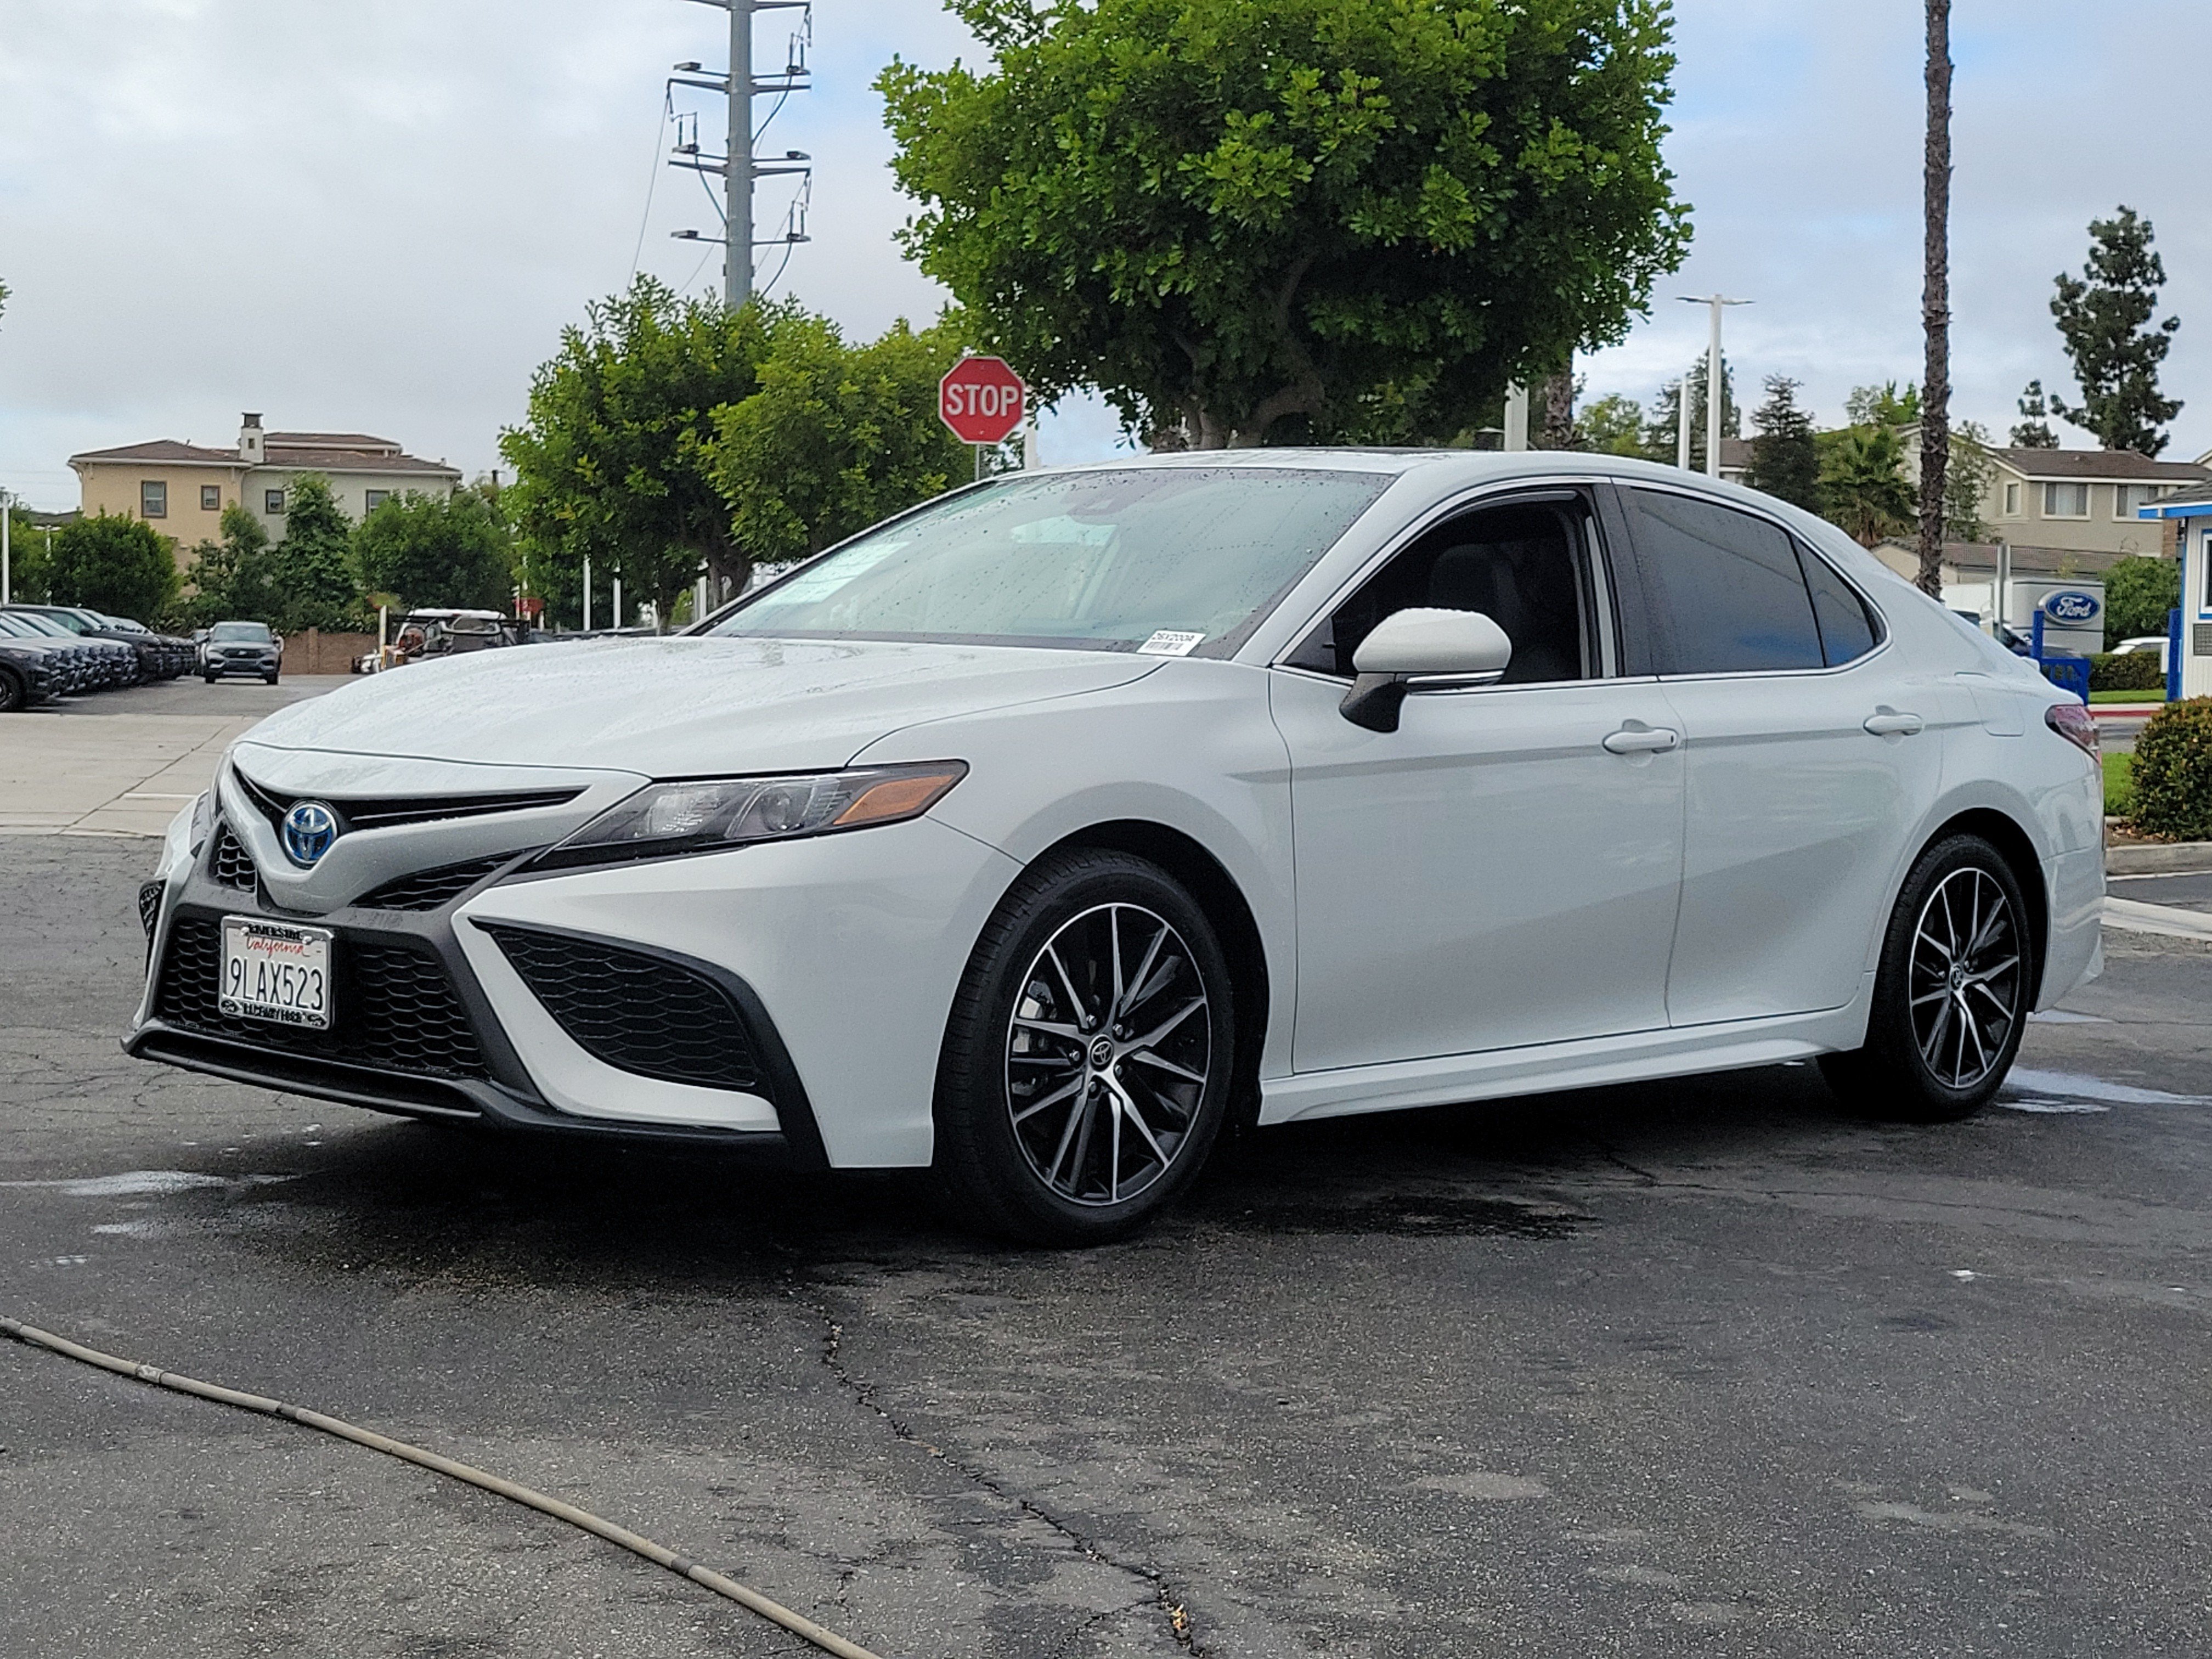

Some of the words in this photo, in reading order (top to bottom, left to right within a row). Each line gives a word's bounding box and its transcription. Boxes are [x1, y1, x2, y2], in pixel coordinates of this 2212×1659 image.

[945, 383, 1019, 416] STOP
[2057, 595, 2091, 617] Ford
[247, 936, 311, 958] California
[230, 957, 323, 1011] 9LAX523
